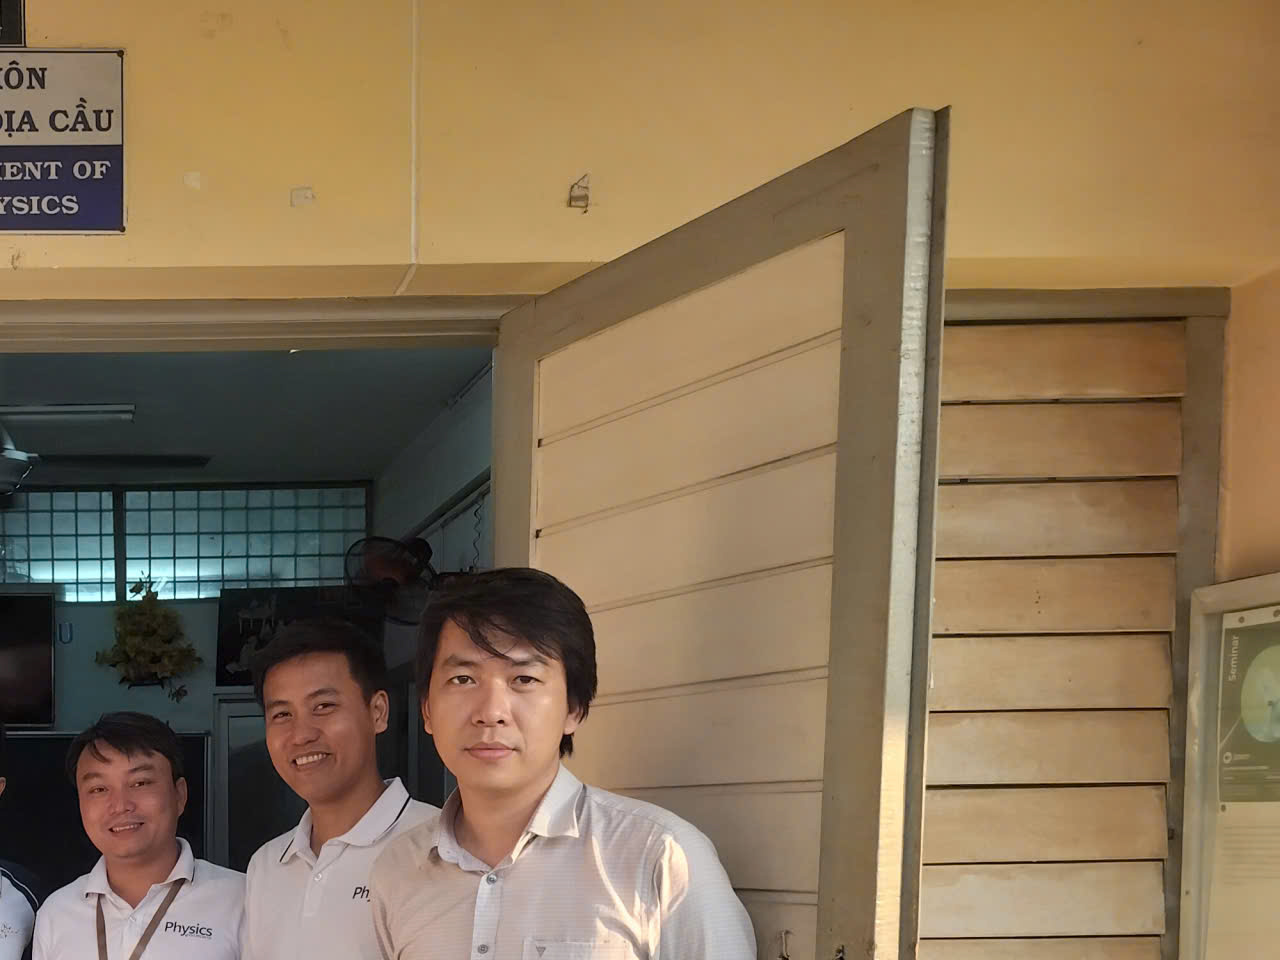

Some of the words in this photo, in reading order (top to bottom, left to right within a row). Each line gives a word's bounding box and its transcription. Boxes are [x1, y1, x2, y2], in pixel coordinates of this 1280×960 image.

[49, 98, 114, 133] CẦU
[72, 161, 111, 179] OF
[1227, 634, 1240, 682] Seminar
[164, 921, 213, 937] Physics
